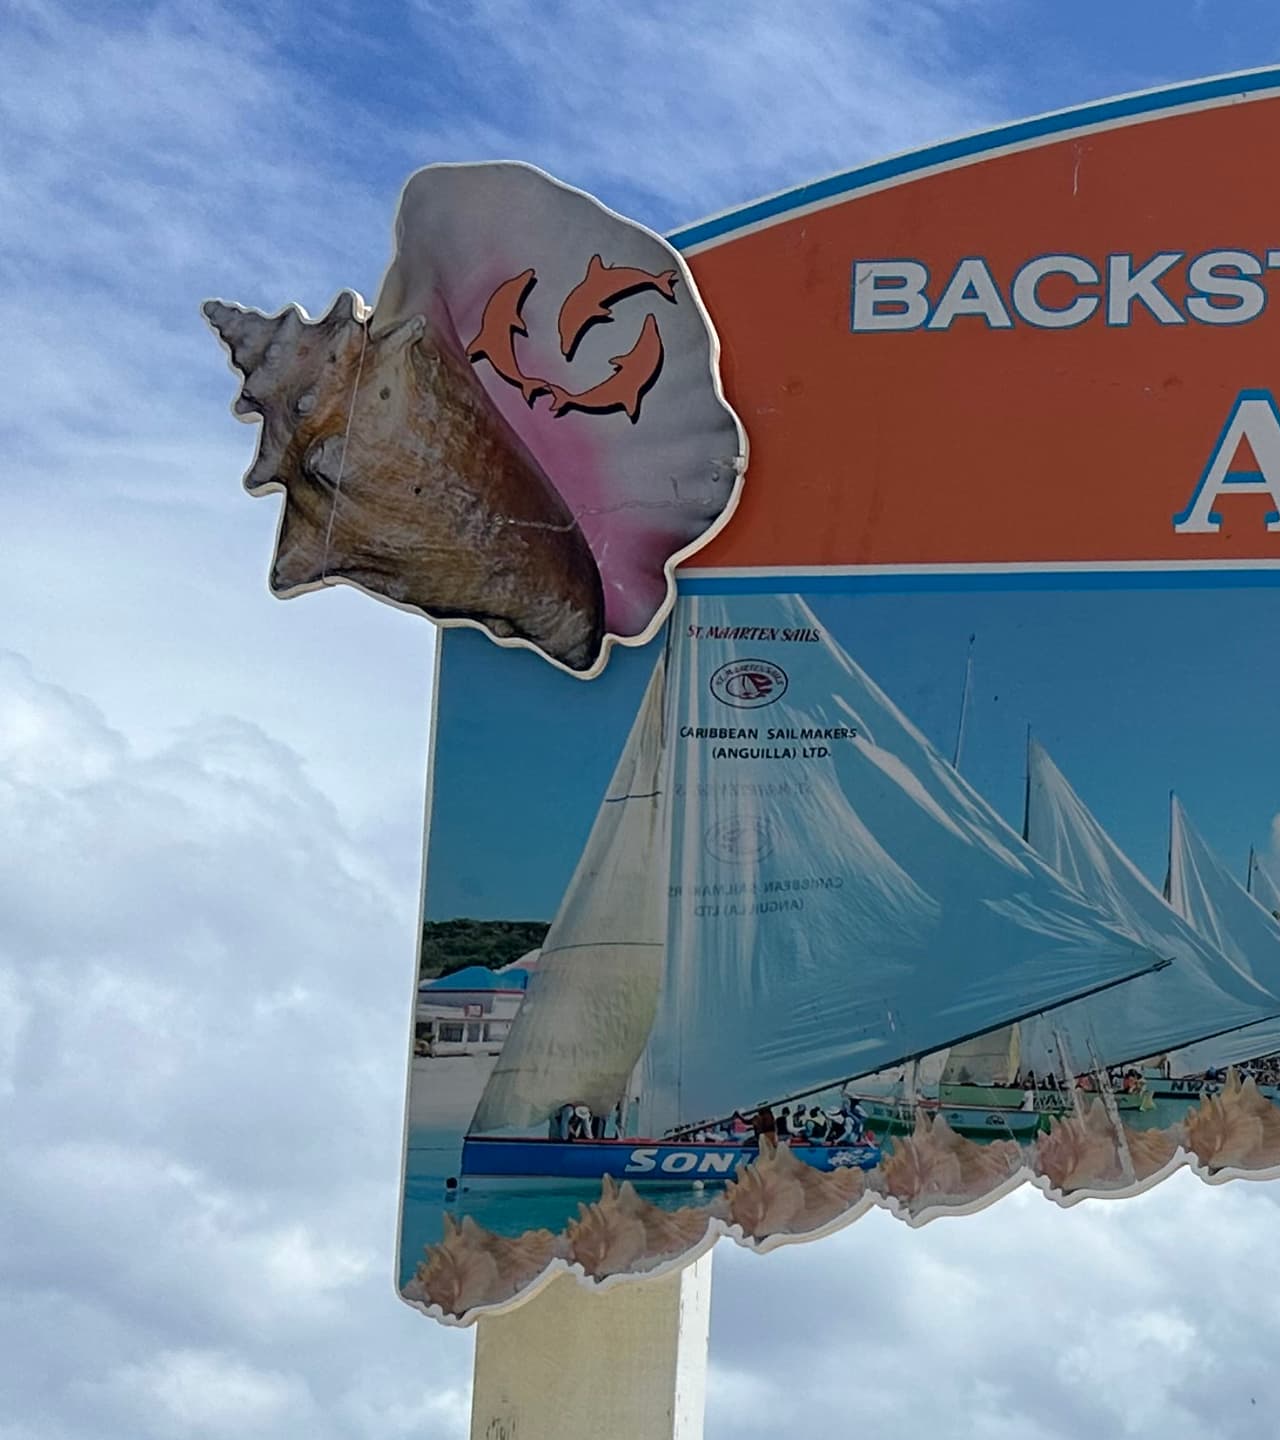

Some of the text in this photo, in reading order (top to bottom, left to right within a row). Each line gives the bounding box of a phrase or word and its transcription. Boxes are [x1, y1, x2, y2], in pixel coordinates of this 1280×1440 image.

[706, 626, 778, 641] MAARTEN
[780, 628, 821, 642] SAILS
[680, 726, 759, 740] CARIBBEAN
[712, 747, 796, 760] (ANGUILLA)
